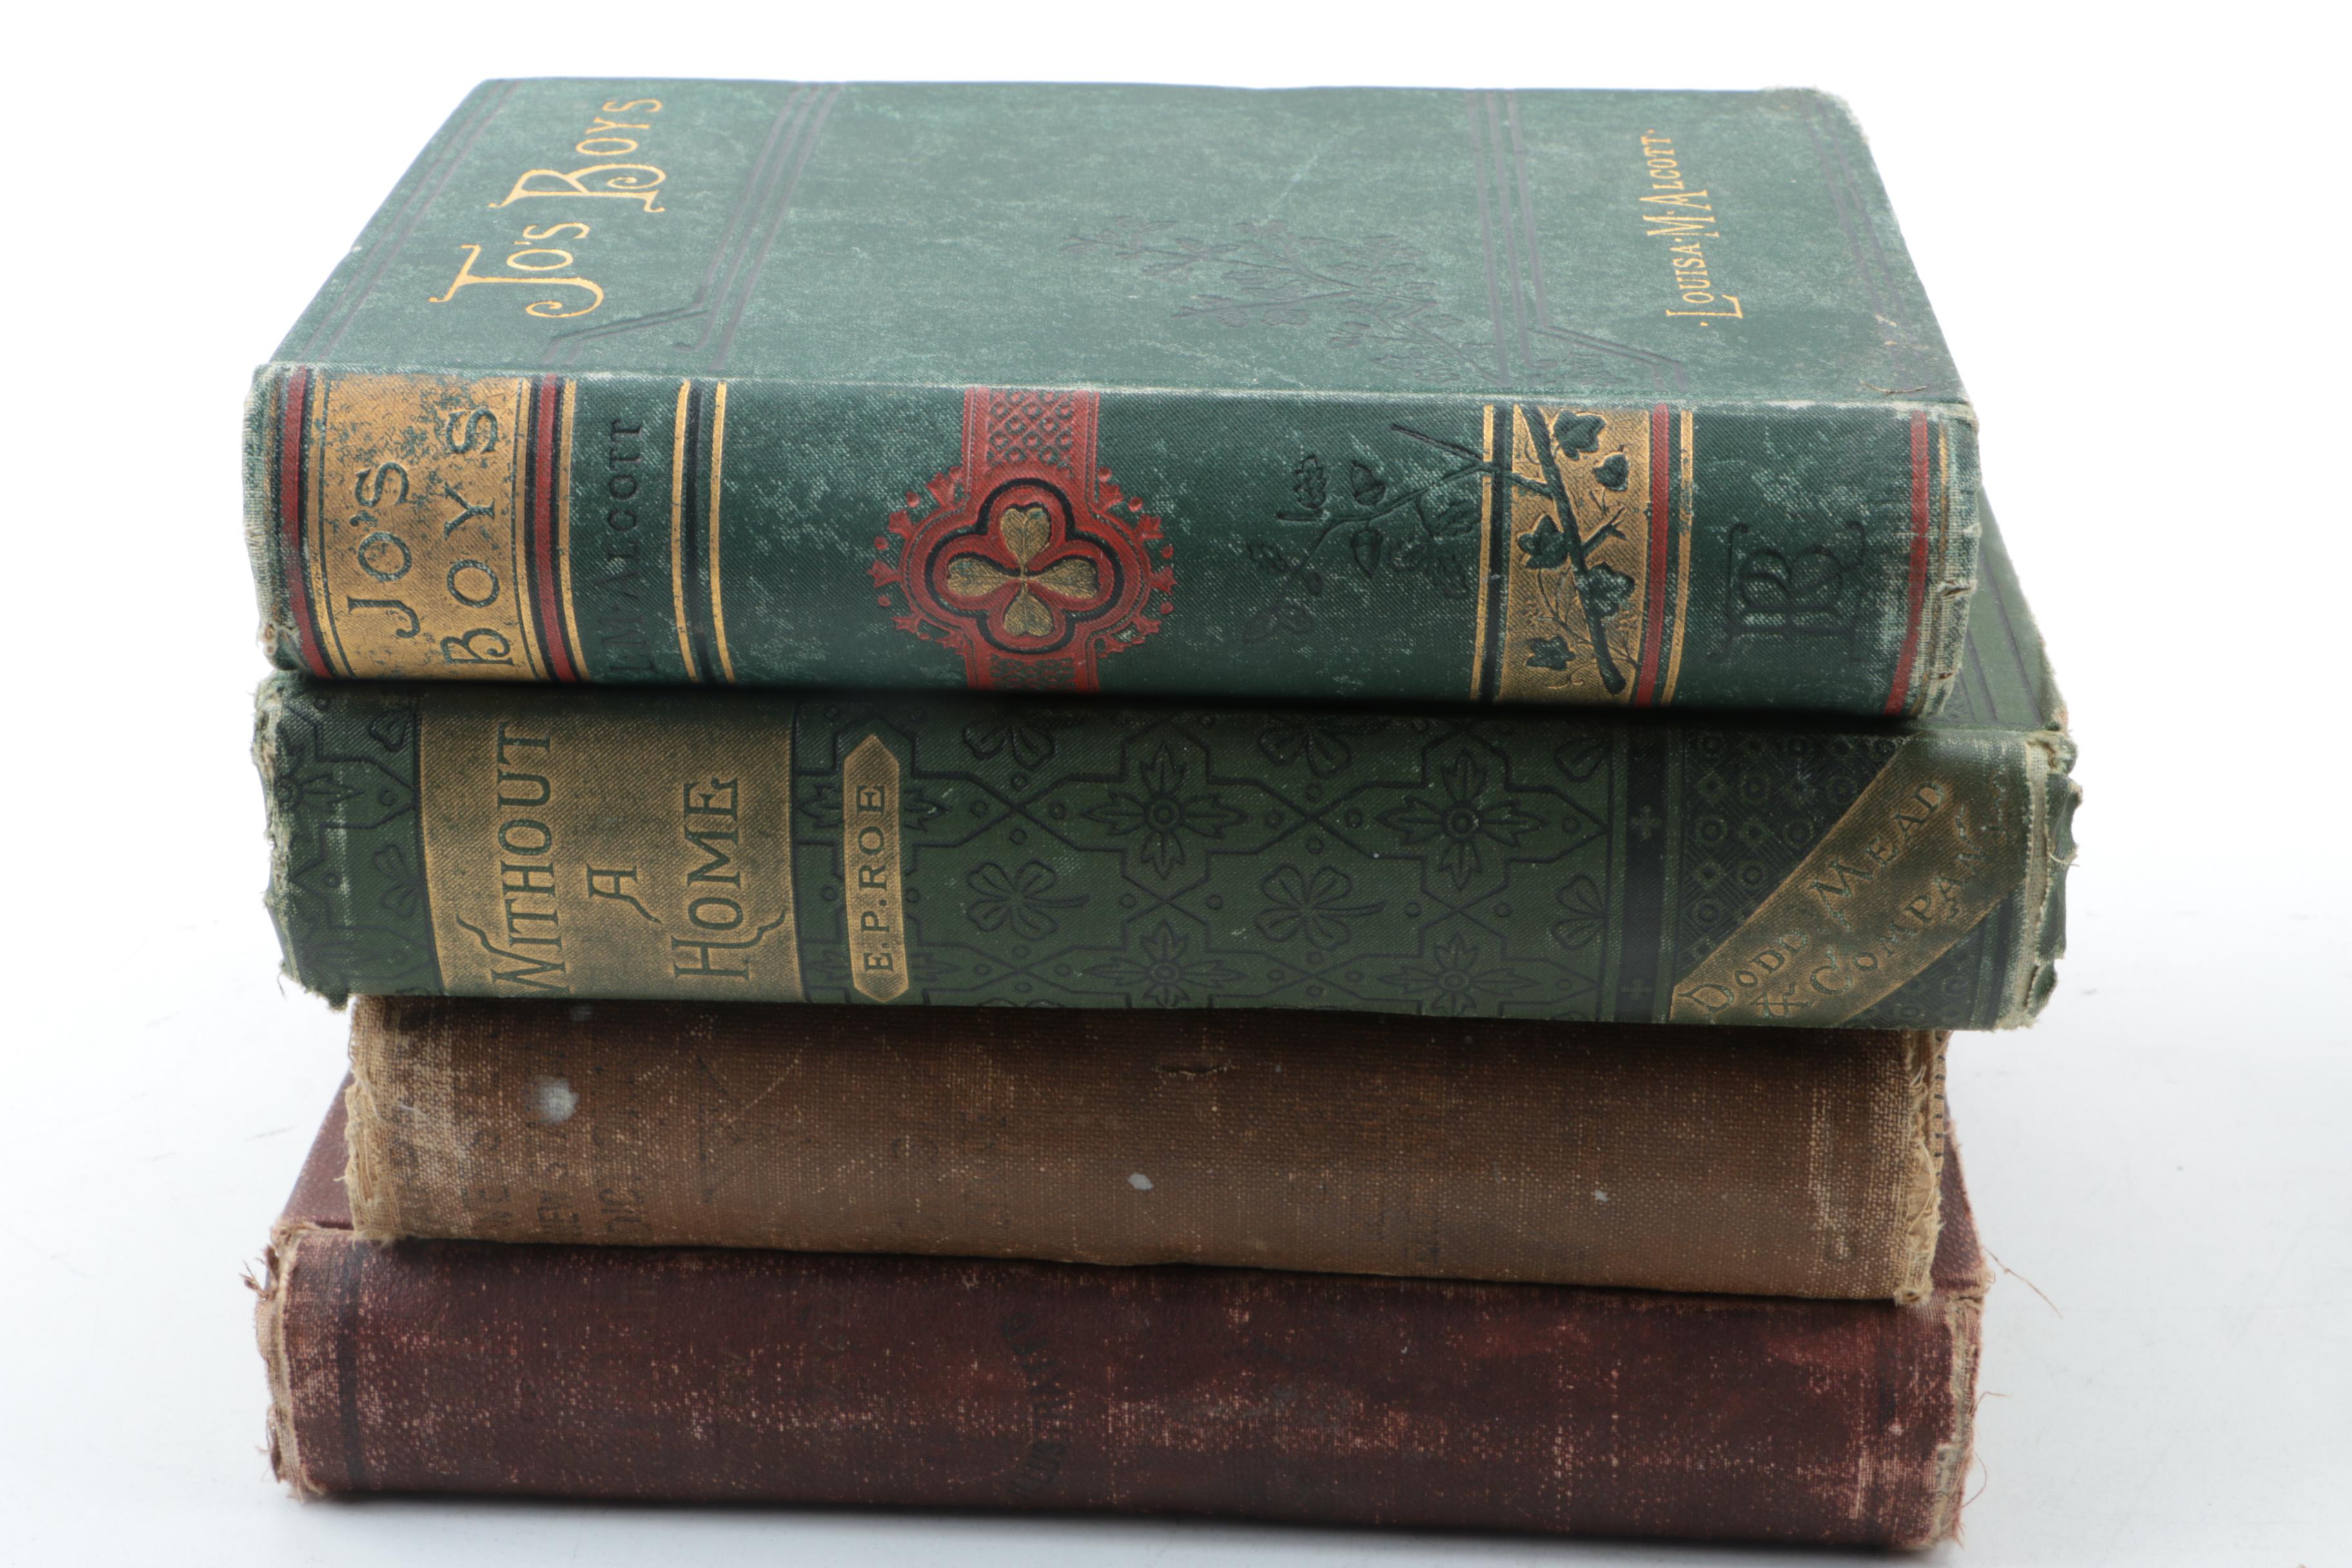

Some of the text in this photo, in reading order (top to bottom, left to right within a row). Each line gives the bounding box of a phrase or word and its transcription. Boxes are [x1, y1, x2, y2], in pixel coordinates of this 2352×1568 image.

[487, 98, 666, 213] BOYS
[346, 407, 514, 666] JO'S BOYS
[456, 720, 571, 995] WITHOUT
[585, 863, 663, 925] A
[671, 776, 787, 982] HOME
[1809, 781, 1947, 932] MEAD
